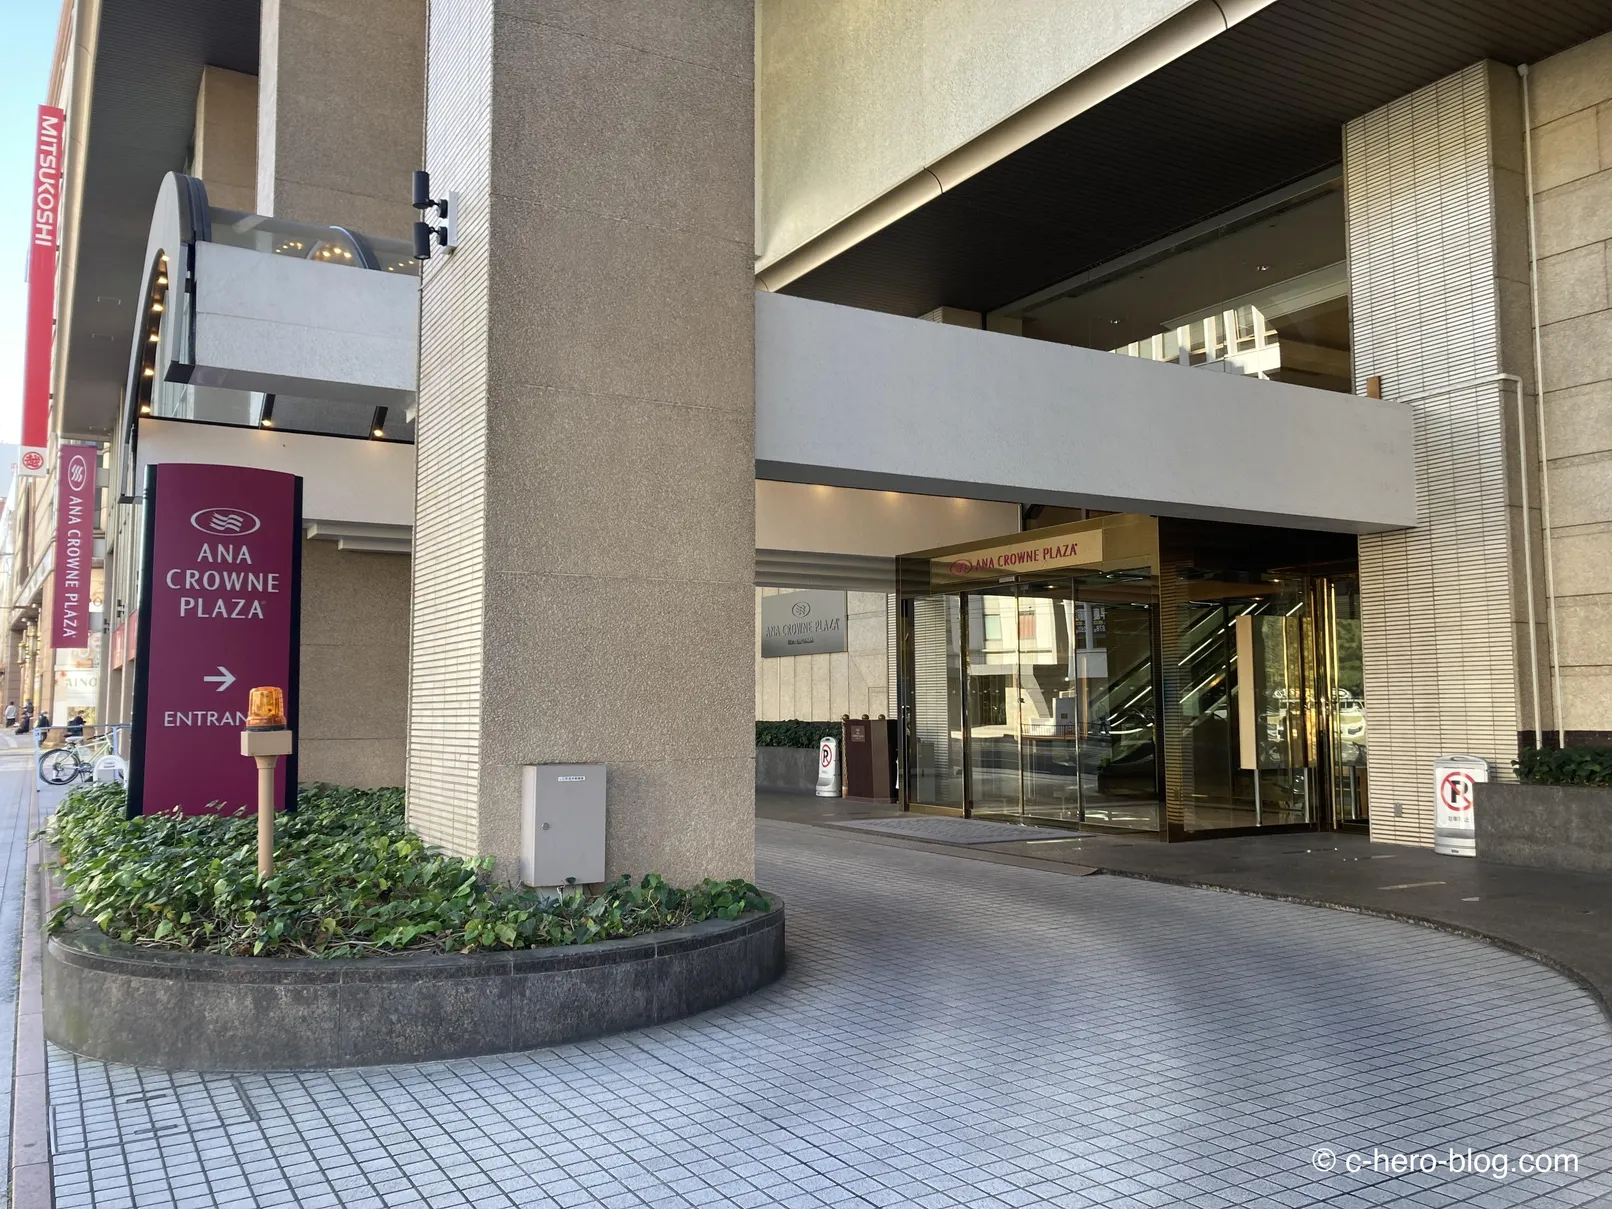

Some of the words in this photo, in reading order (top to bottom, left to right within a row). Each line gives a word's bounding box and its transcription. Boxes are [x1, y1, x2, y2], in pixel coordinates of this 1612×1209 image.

[35, 115, 59, 246] MITSUKOSHI
[67, 495, 83, 525] ANA
[64, 530, 81, 588] CROWNE
[197, 543, 252, 565] ANA
[975, 557, 995, 571] ANA
[997, 549, 1040, 568] CROWNE
[1042, 543, 1077, 560] PLAZA
[166, 569, 280, 593] CROWNE
[63, 594, 79, 637] PLAZA
[180, 597, 264, 619] PLAZA
[782, 621, 812, 637] CROWNE
[815, 618, 840, 633] PLAZA
[164, 711, 248, 726] ENTRAN
